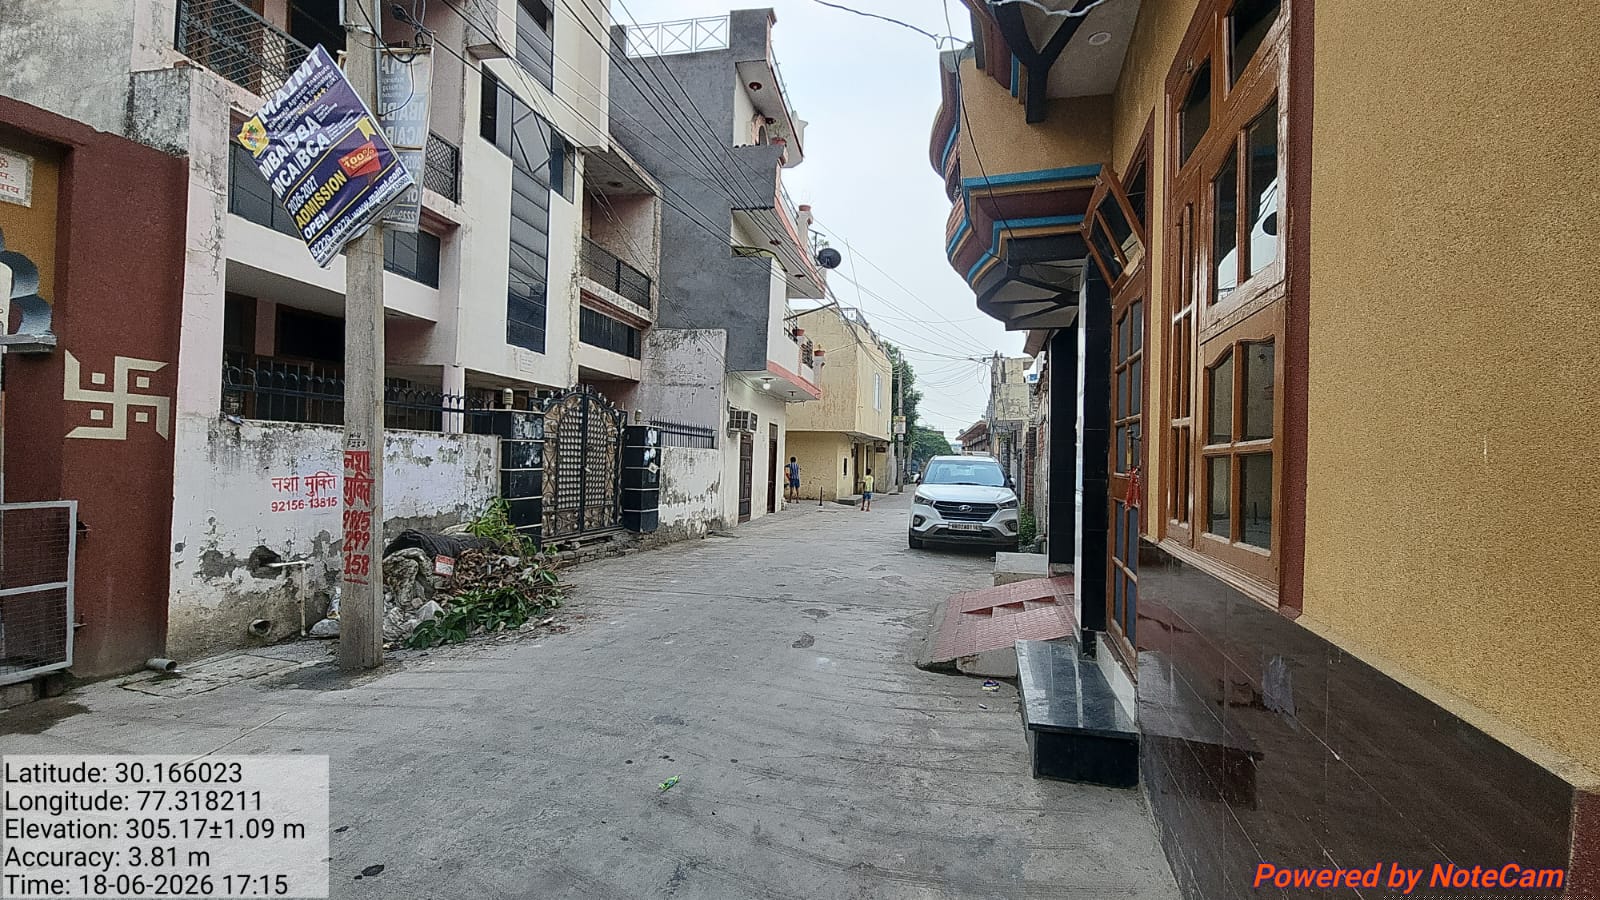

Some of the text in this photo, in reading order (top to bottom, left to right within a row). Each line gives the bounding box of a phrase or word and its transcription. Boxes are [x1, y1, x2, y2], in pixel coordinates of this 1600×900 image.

[257, 46, 322, 124] MAIMT
[343, 147, 375, 168] 100%
[288, 175, 319, 215] 2026-2027
[295, 169, 347, 229] ADMISSION
[304, 210, 330, 239] OPEN
[344, 451, 370, 474] नशा
[271, 471, 338, 498] नशा मुक्ति
[271, 497, 338, 513] 92156-13815
[343, 531, 370, 551] 299
[344, 553, 370, 576] 158
